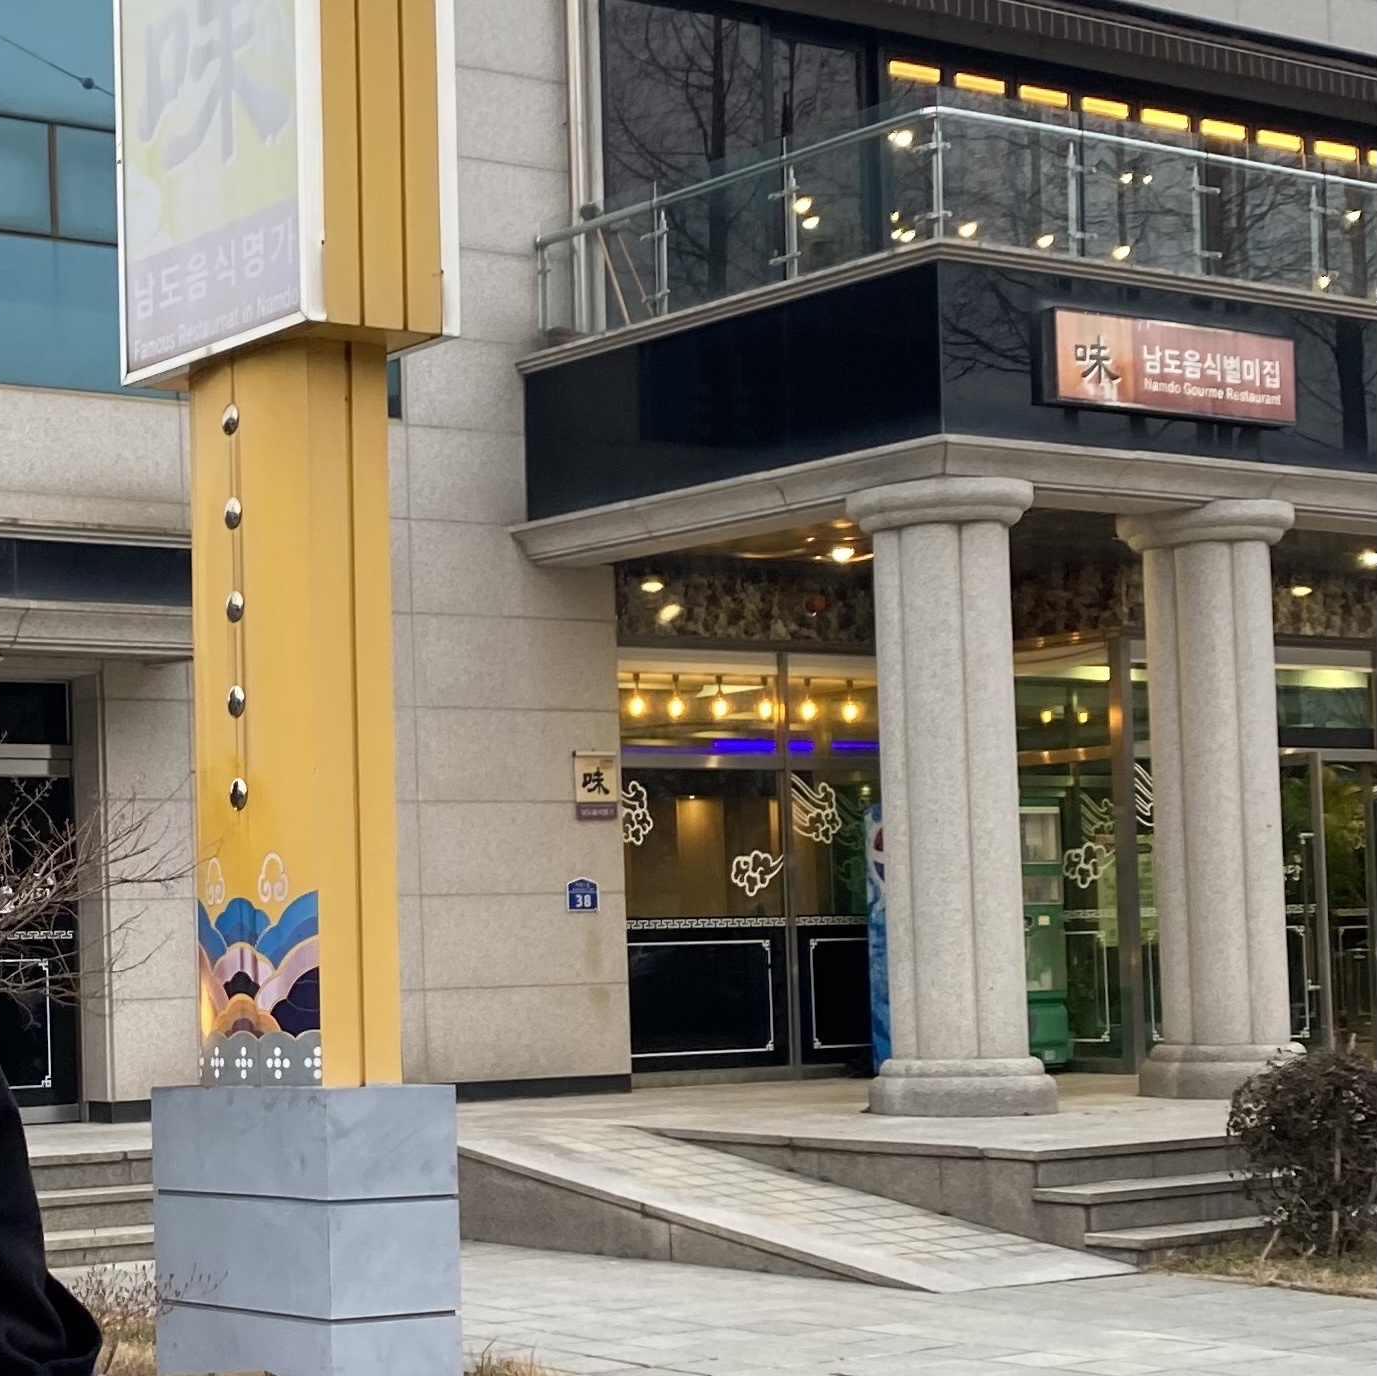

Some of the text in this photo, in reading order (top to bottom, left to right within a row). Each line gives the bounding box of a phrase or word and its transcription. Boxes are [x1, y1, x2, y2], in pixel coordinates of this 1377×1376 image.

[133, 214, 298, 321] 남도음식명가
[133, 334, 176, 362] Famous
[240, 301, 254, 324] in
[256, 284, 299, 318] Namdo
[1074, 333, 1121, 384] 味
[1142, 344, 1282, 390] 남도음식별미집
[1143, 377, 1282, 406] Namdo Gourme Restaurant
[581, 766, 610, 795] 味
[575, 893, 592, 908] 38
